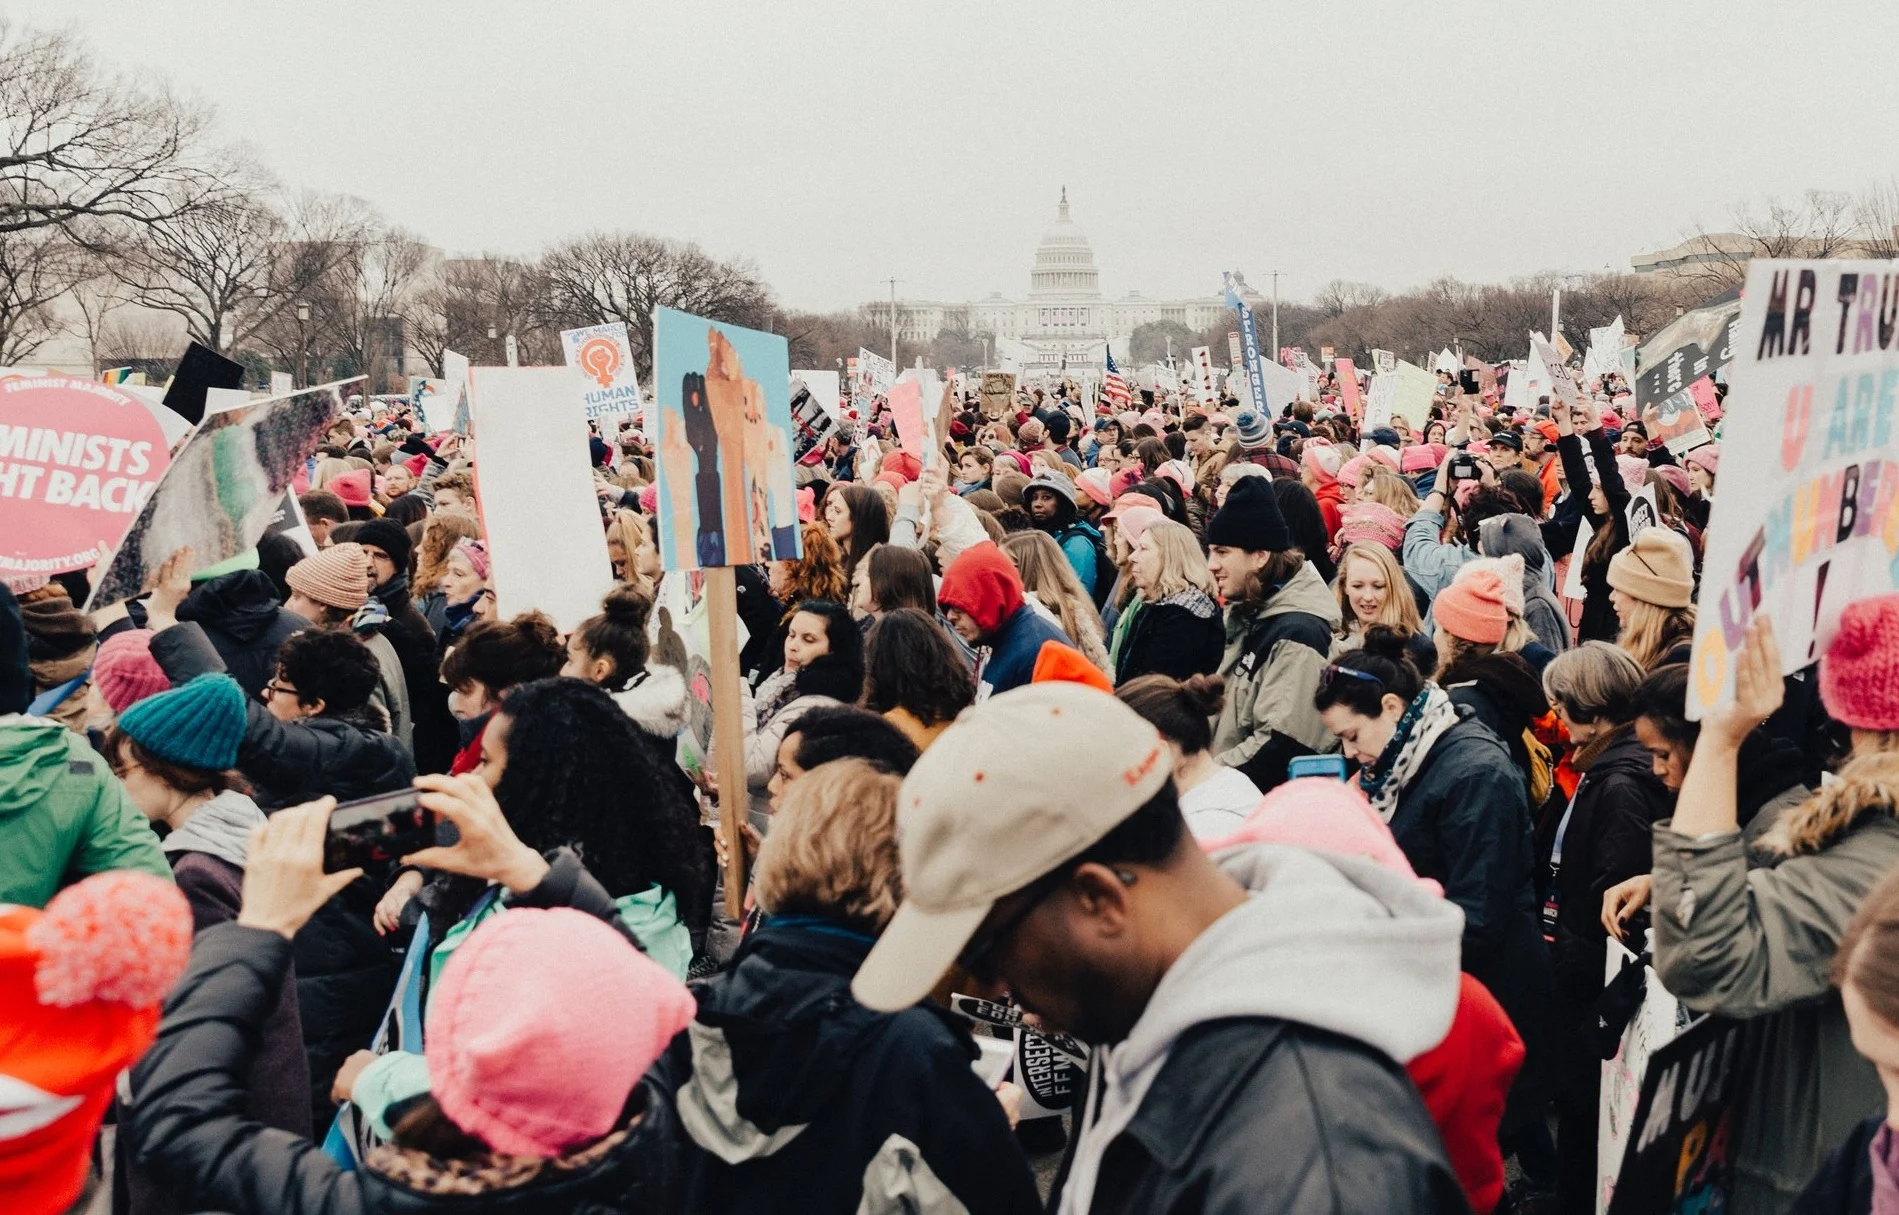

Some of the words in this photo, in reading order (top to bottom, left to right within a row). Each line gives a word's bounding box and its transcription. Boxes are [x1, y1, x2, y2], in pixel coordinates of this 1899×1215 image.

[593, 324, 625, 334] MARCH
[1757, 270, 1816, 360] MR
[1836, 273, 1899, 354] TRU
[1241, 306, 1266, 413] STRONGER
[4, 378, 67, 393] FEMINIST
[585, 385, 635, 404] HUMAN
[585, 399, 639, 417] RIGHTS
[1781, 384, 1813, 473] U
[1821, 369, 1899, 461] ARE
[0, 424, 152, 476] MINISTS
[44, 470, 156, 513] BACK
[0, 548, 99, 571] MAJORITY.ORG
[1024, 1033, 1053, 1097] INTERSECT
